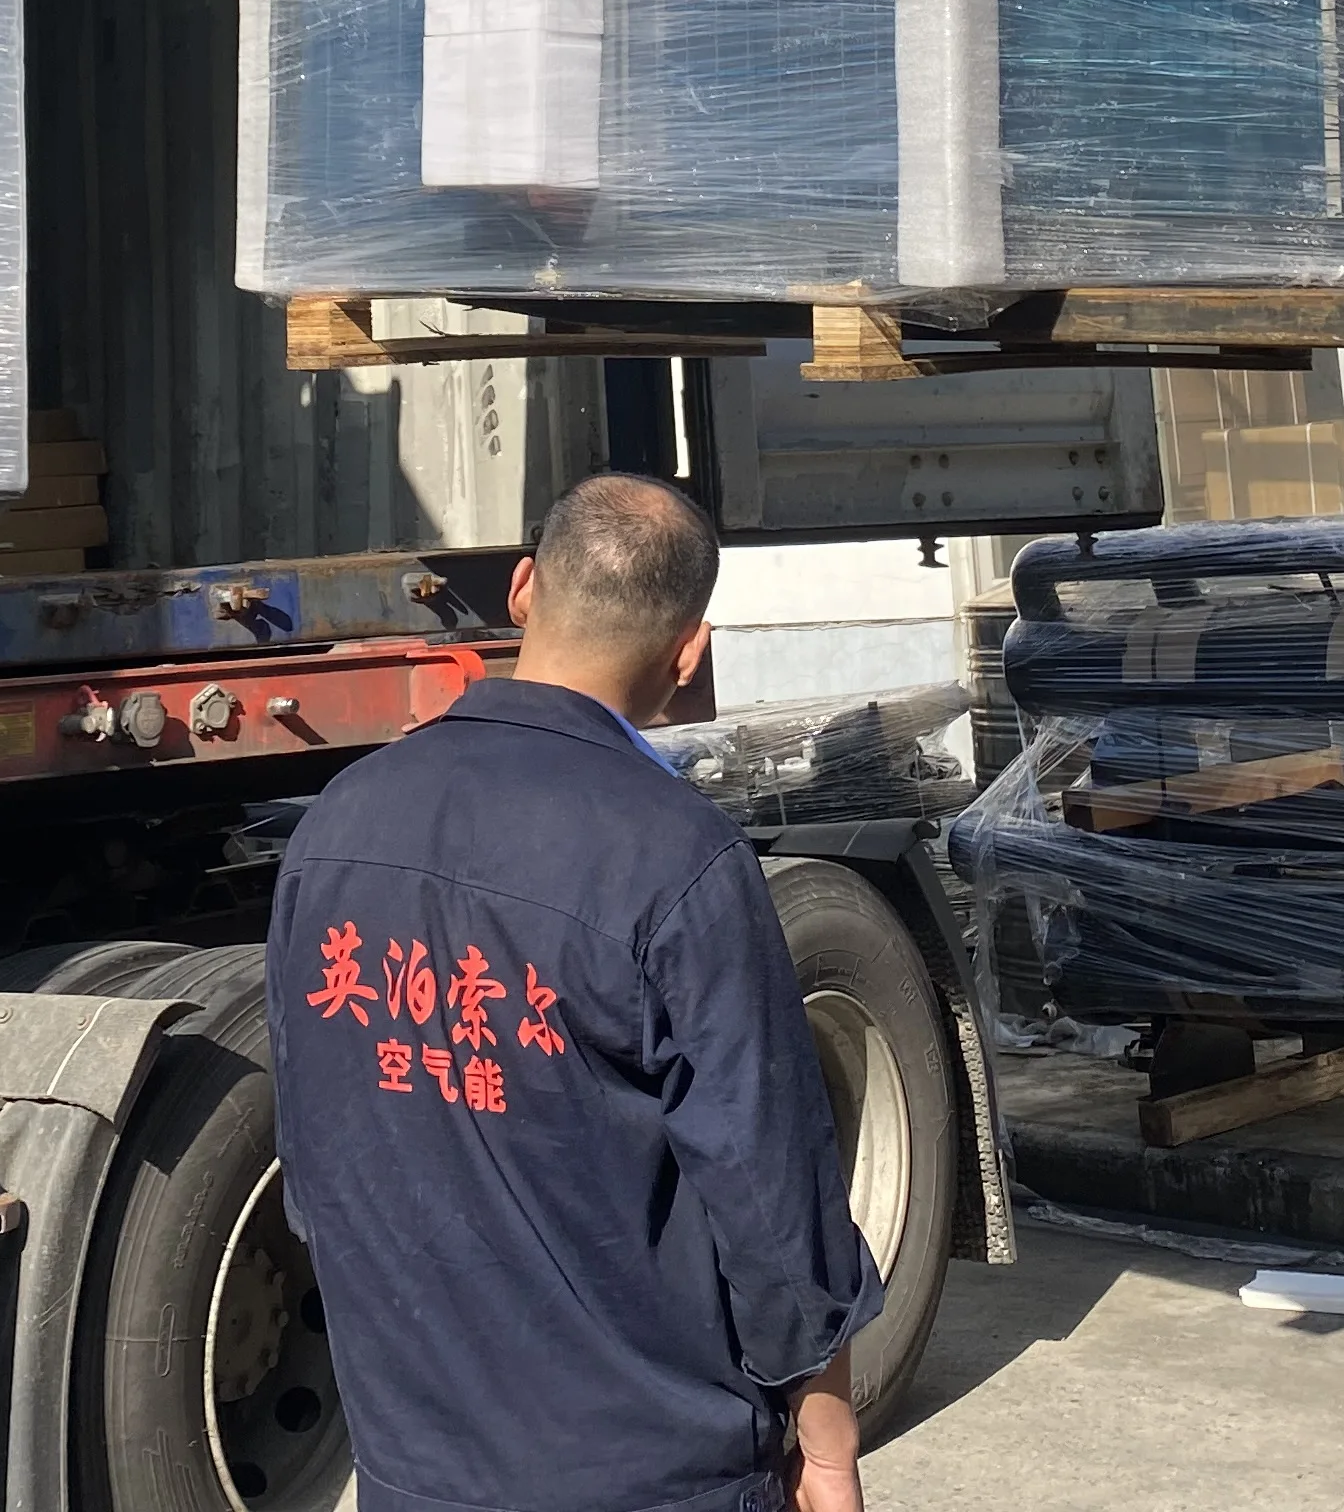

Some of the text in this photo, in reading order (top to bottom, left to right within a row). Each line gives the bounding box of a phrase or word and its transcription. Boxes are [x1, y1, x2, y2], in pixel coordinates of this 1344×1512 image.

[307, 921, 565, 1056] 英泊索尔
[377, 1039, 507, 1113] 空气能
